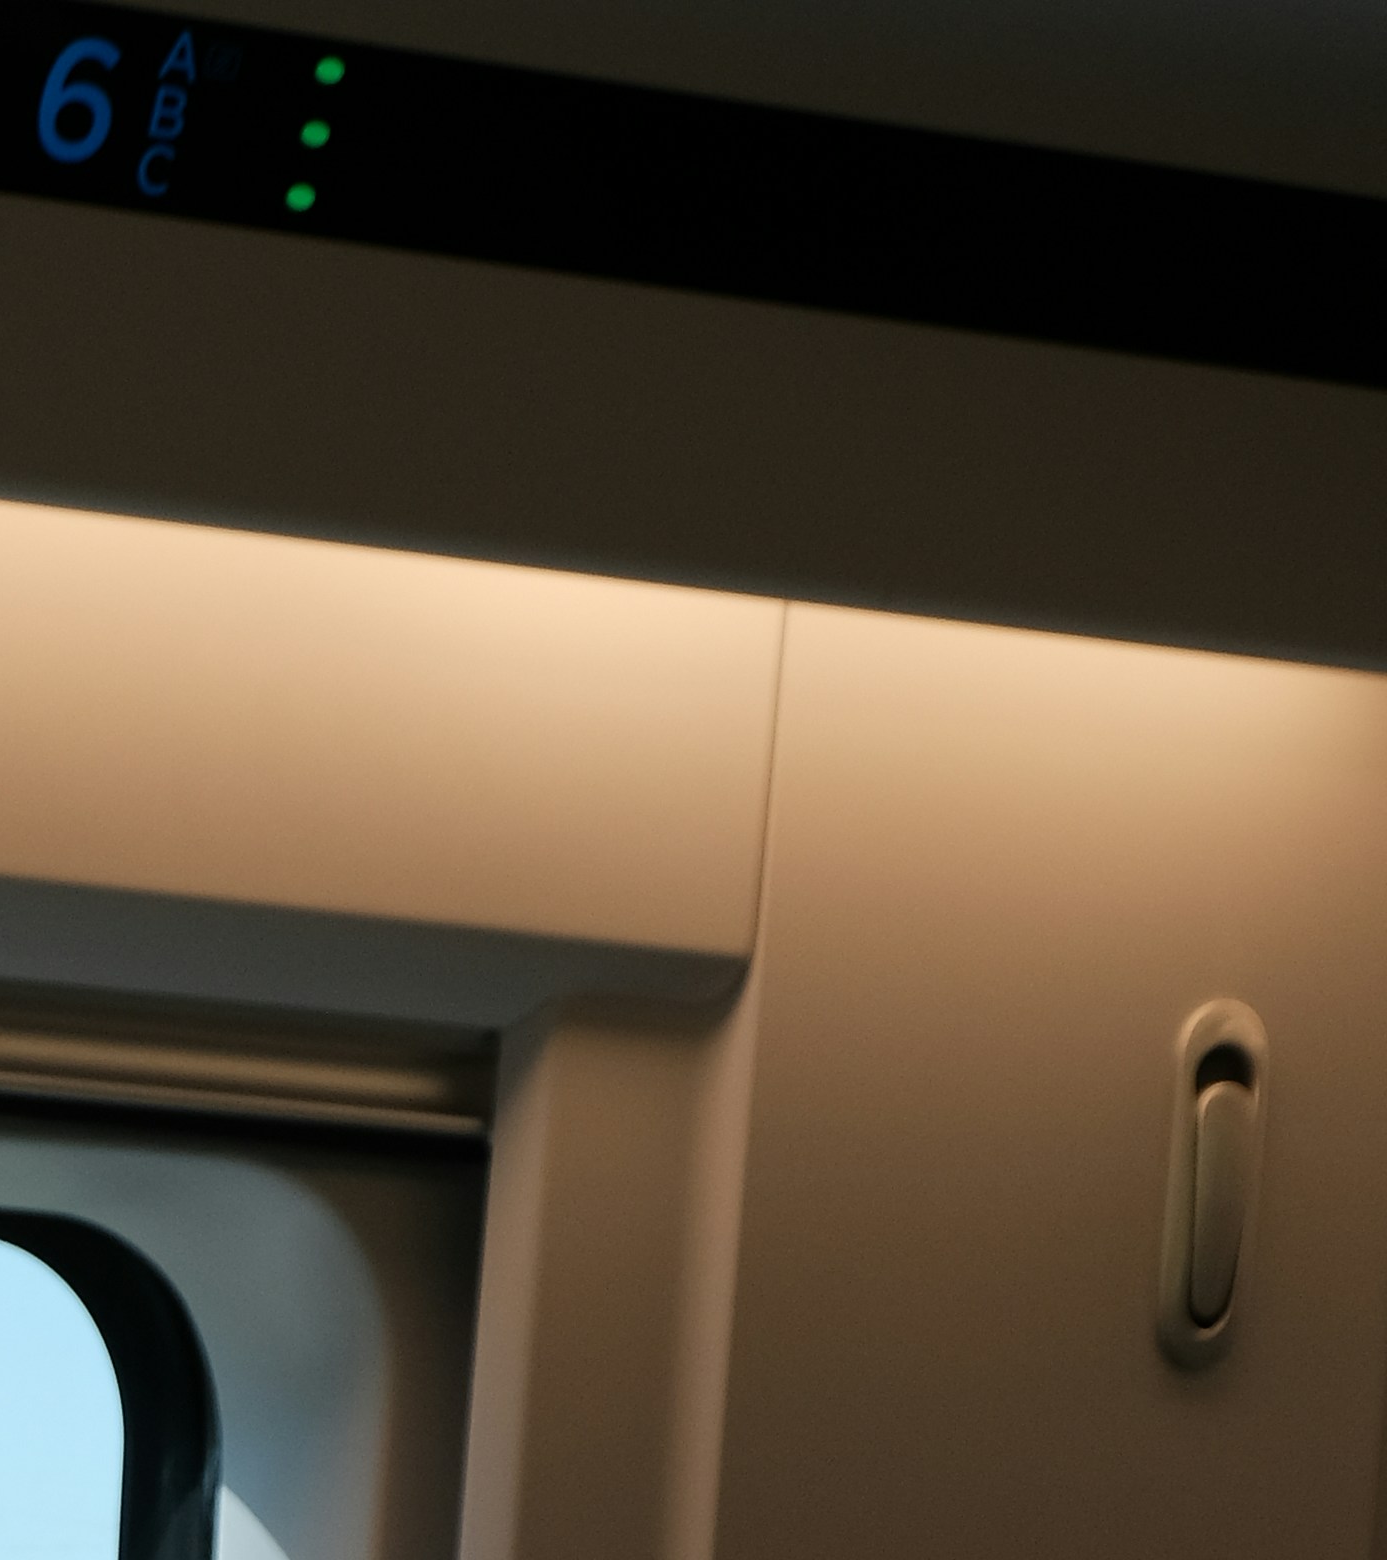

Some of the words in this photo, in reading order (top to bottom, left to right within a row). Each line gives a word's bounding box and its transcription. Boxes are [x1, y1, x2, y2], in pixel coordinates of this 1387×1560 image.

[159, 29, 197, 83] A
[38, 37, 121, 163] 6
[148, 86, 188, 139] B
[137, 146, 175, 196] C
